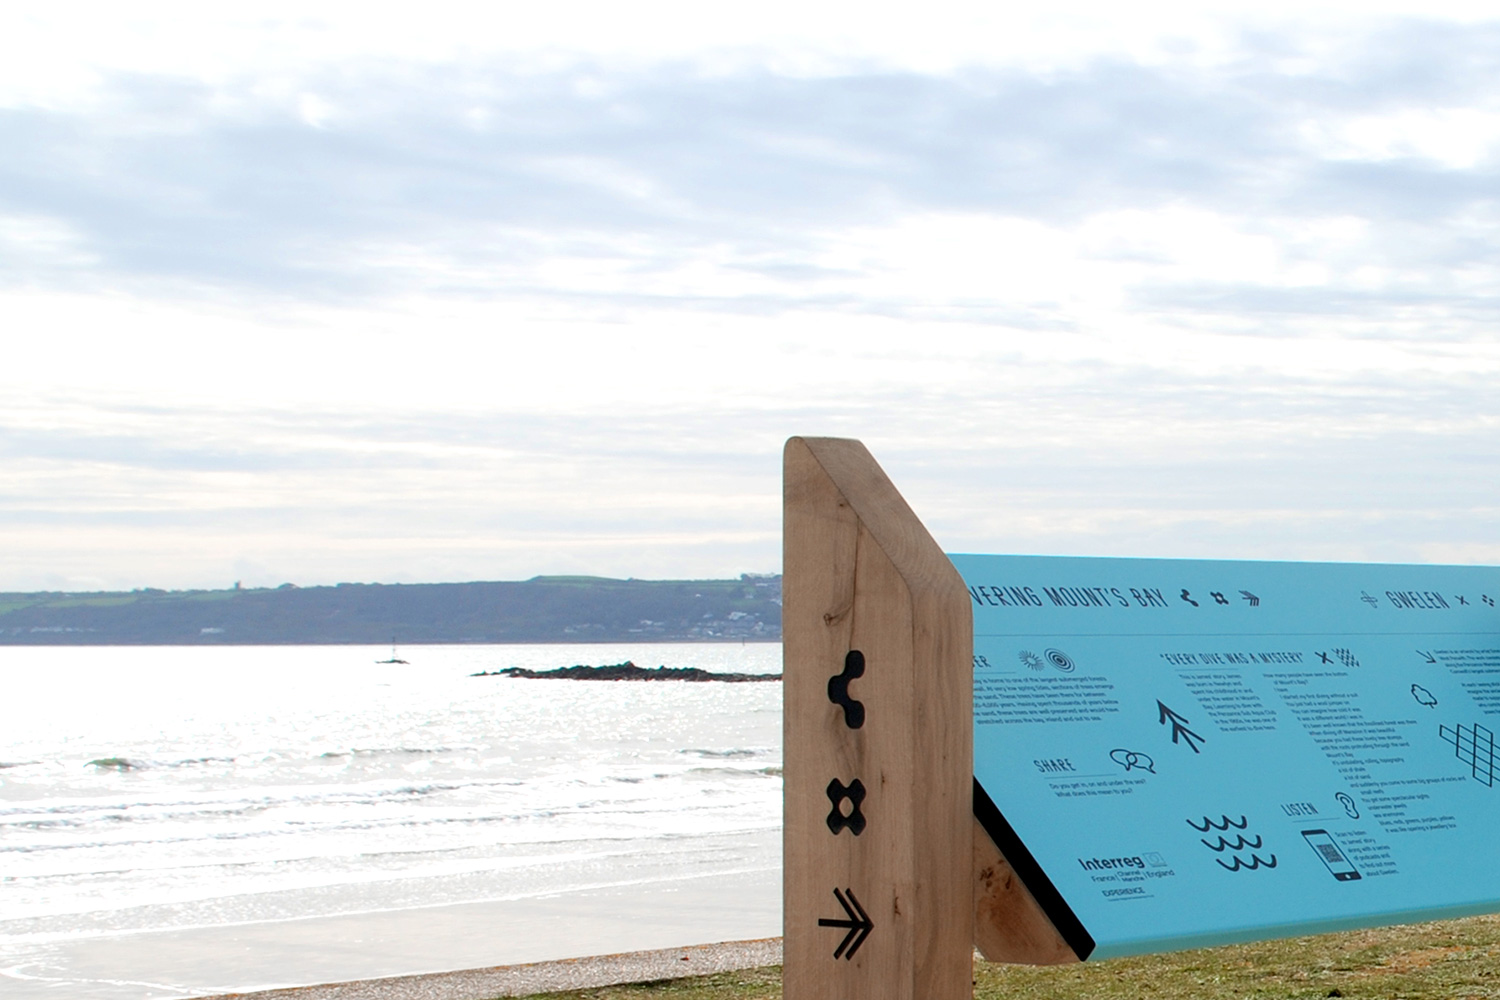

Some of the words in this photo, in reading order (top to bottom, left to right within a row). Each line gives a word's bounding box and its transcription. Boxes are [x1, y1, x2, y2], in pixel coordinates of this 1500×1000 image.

[1043, 586, 1129, 607] MOUNT'S
[1130, 588, 1169, 607] BAY
[1385, 590, 1450, 609] GWELEN
[1200, 652, 1224, 665] DIVE
[1223, 652, 1249, 664] WAS
[1249, 652, 1260, 664] A
[1033, 758, 1076, 773] SHARE
[1280, 802, 1319, 817] LISTEN
[1078, 855, 1146, 871] Interreg
[1091, 874, 1116, 883] France
[1146, 869, 1175, 880] England
[1102, 886, 1147, 898] EXPERIENCE
